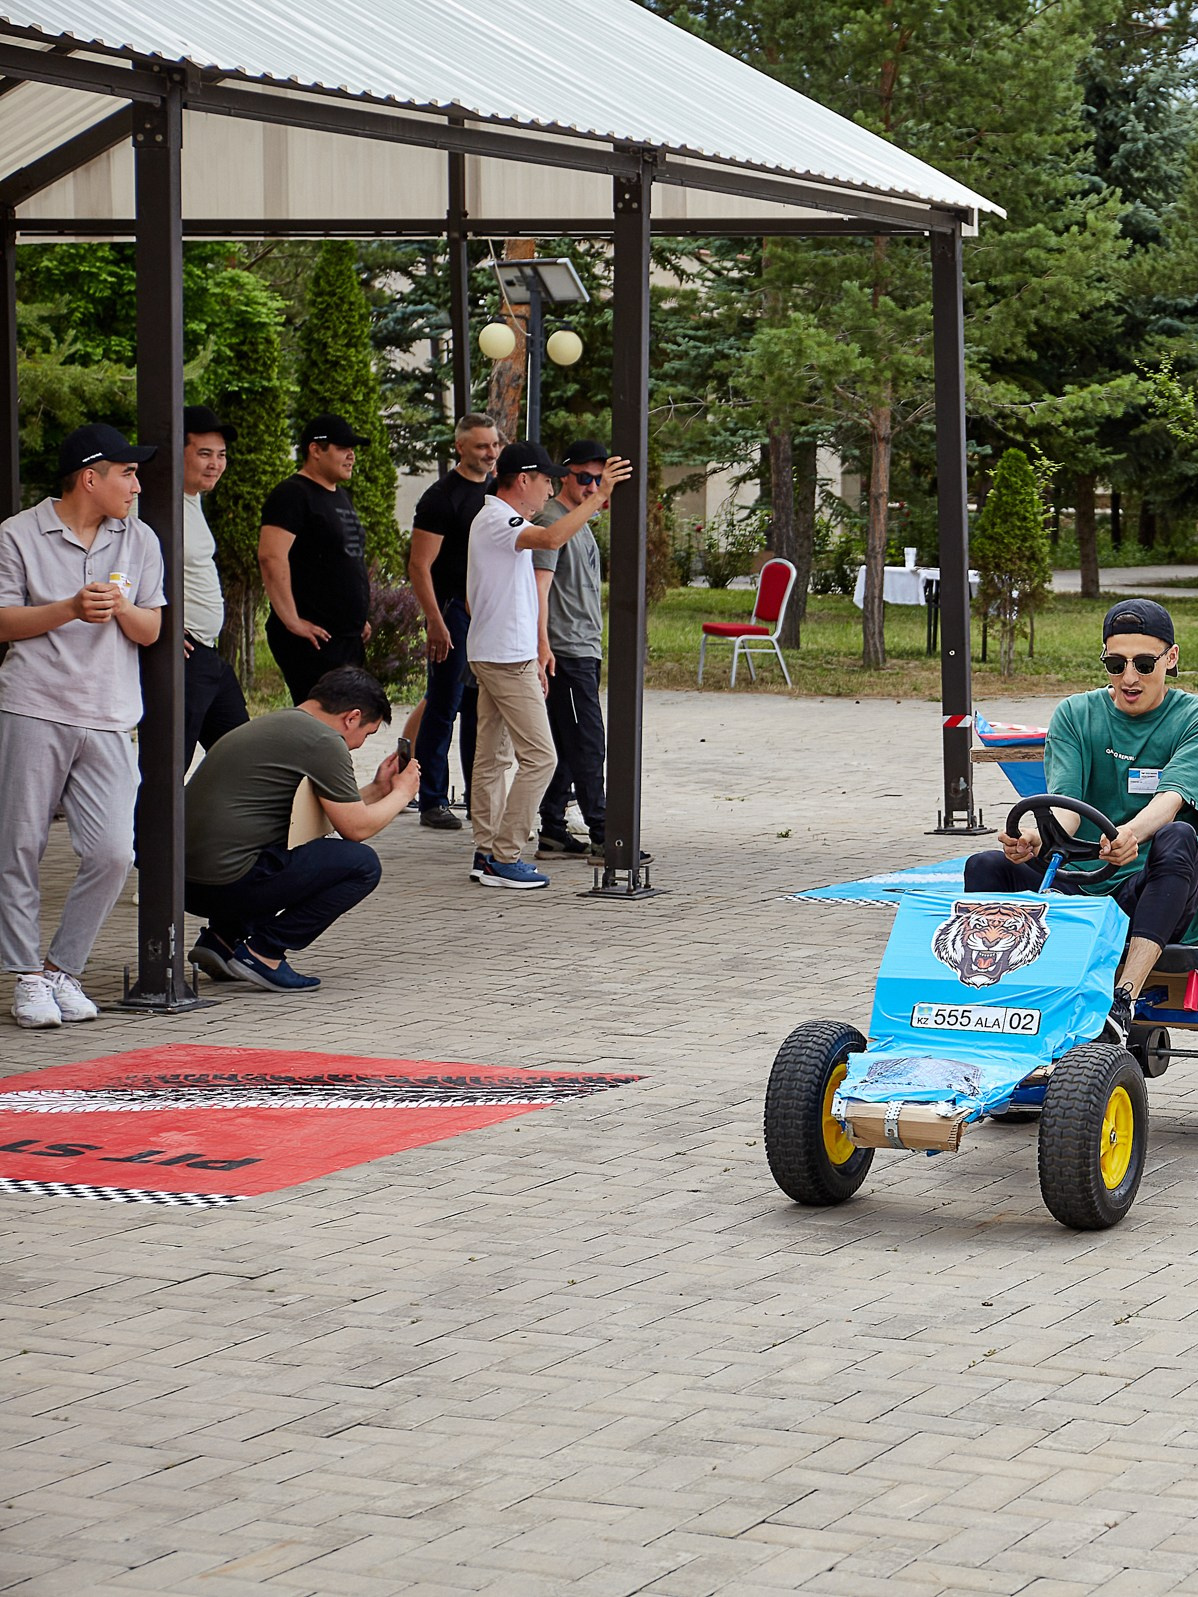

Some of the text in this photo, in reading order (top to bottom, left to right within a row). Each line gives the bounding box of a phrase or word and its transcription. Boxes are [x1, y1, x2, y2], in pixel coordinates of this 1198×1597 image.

[916, 1008, 1035, 1031] KZ 555 ALA 02
[98, 1149, 265, 1171] PIT
